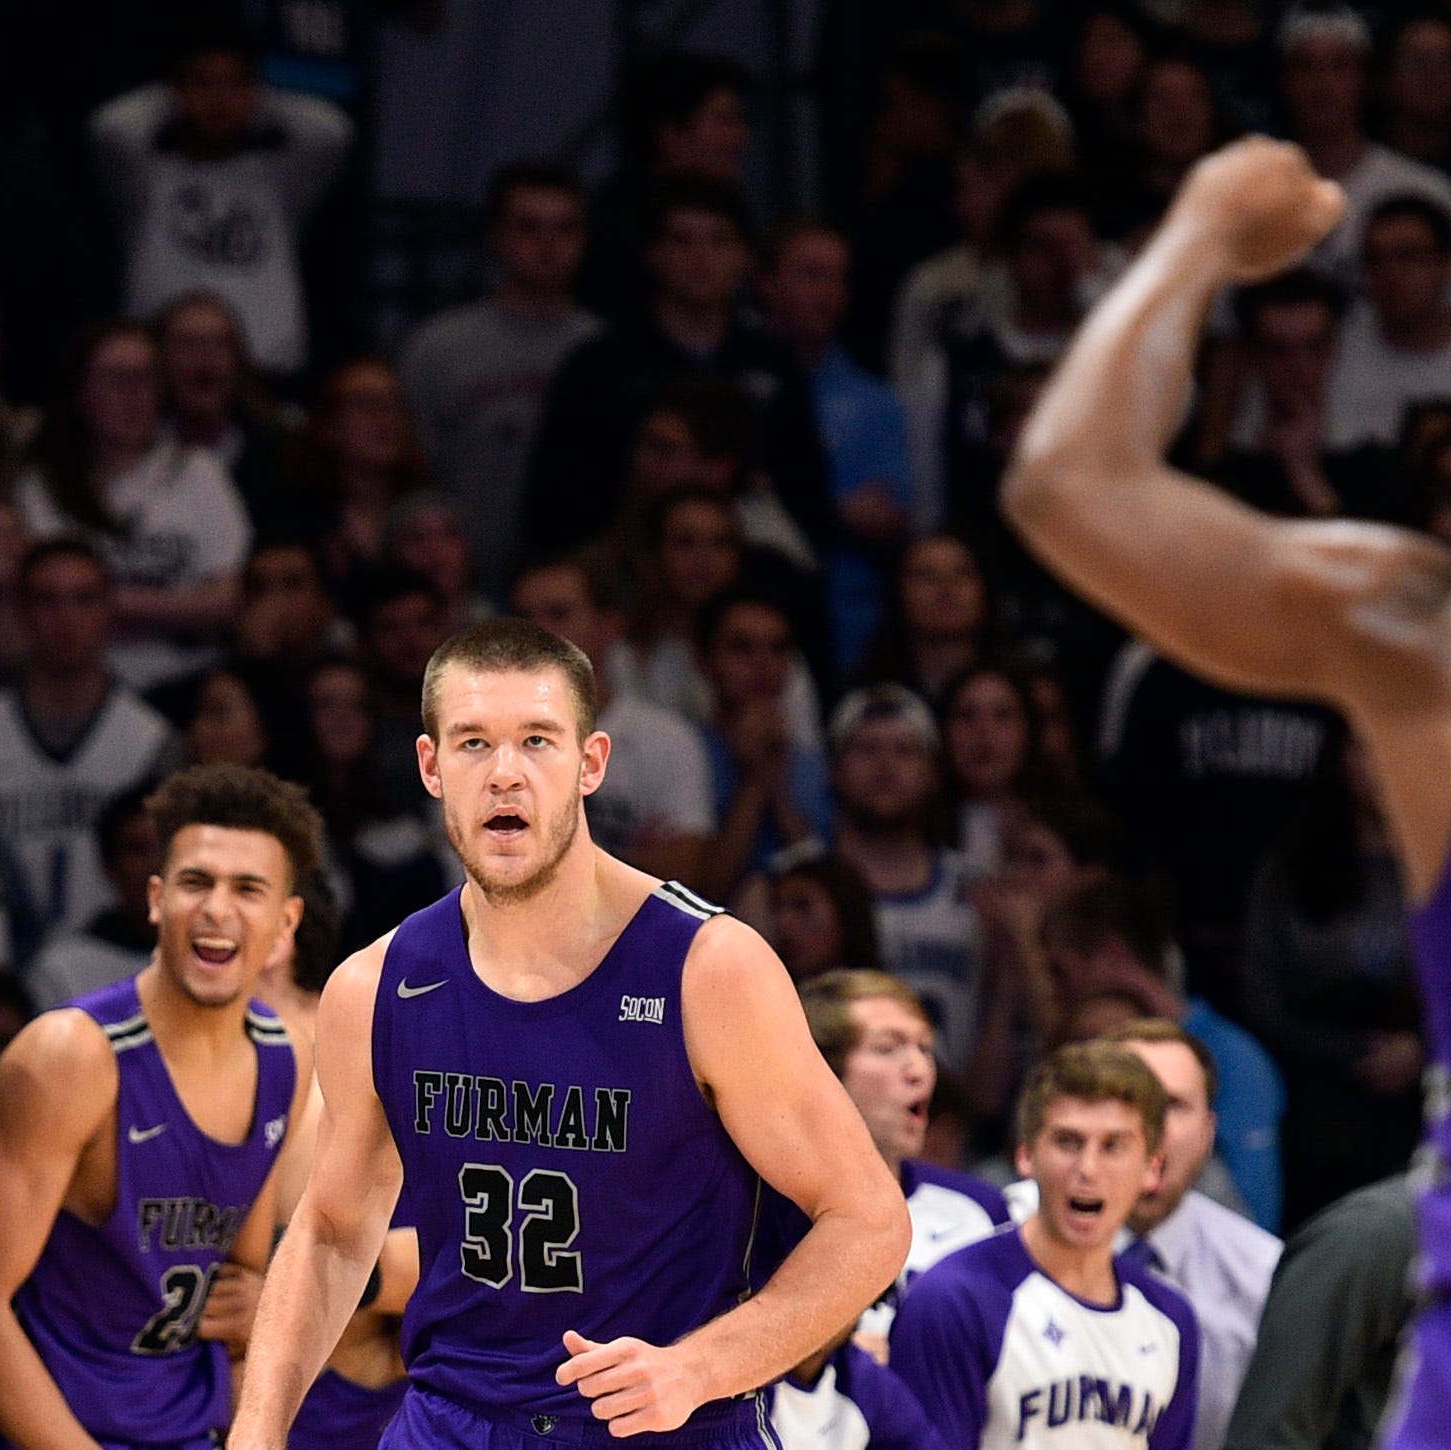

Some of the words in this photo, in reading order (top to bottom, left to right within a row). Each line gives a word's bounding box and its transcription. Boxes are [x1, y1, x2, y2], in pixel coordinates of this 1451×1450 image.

[618, 994, 666, 1025] SOCON
[413, 1070, 632, 1152] FURMAN
[457, 1162, 584, 1294] 32
